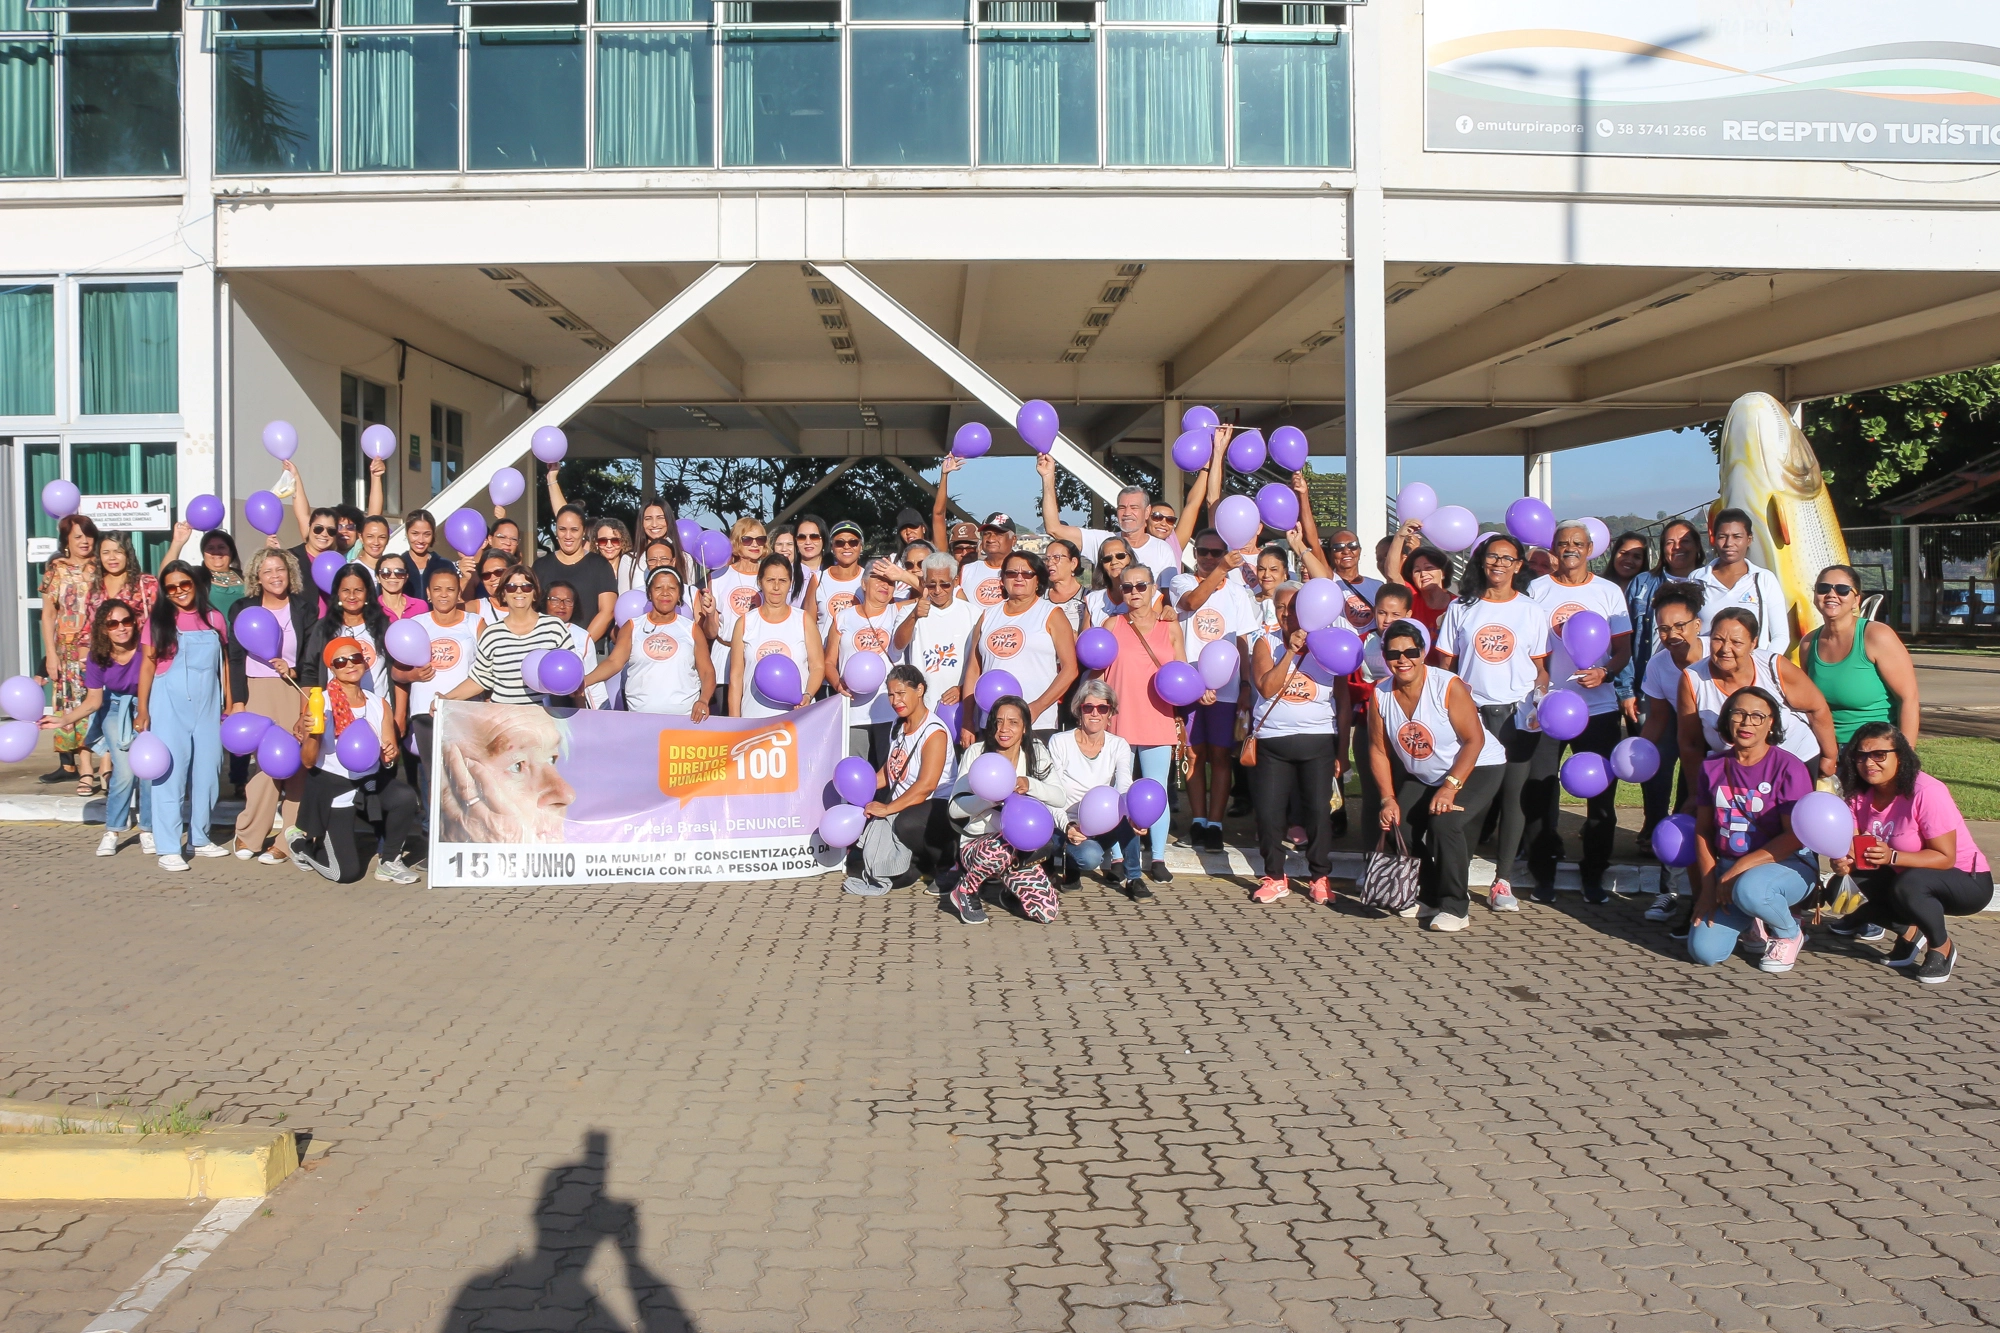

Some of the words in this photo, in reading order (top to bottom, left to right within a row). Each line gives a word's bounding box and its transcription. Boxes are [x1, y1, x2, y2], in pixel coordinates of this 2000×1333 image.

[1477, 121, 1584, 134] emuturpirapora
[1617, 123, 1633, 134] 38
[1638, 124, 1668, 135] 3741
[1672, 125, 1706, 136] 2366
[1723, 120, 1878, 143] RECEPTIVO
[96, 499, 139, 511] ATENÇÃO
[669, 745, 728, 760] DISQUE
[669, 758, 727, 775] DIREITOS
[733, 747, 787, 779] 100
[669, 767, 727, 788] HUMANOS
[677, 820, 721, 833] Brasil.
[726, 816, 805, 832] DENUNCIE.
[586, 854, 607, 863] DIA
[694, 845, 815, 861] CONSCIENTIZAÇÃO
[818, 844, 830, 854] DA
[448, 852, 489, 879] 15
[498, 853, 517, 878] DE
[522, 853, 576, 878] JUNHO
[585, 866, 655, 877] VIOLÊNCIA
[660, 865, 712, 876] CONTRA
[716, 865, 725, 874] A
[729, 863, 778, 873] PESSOA
[782, 859, 819, 870] IDOSA
